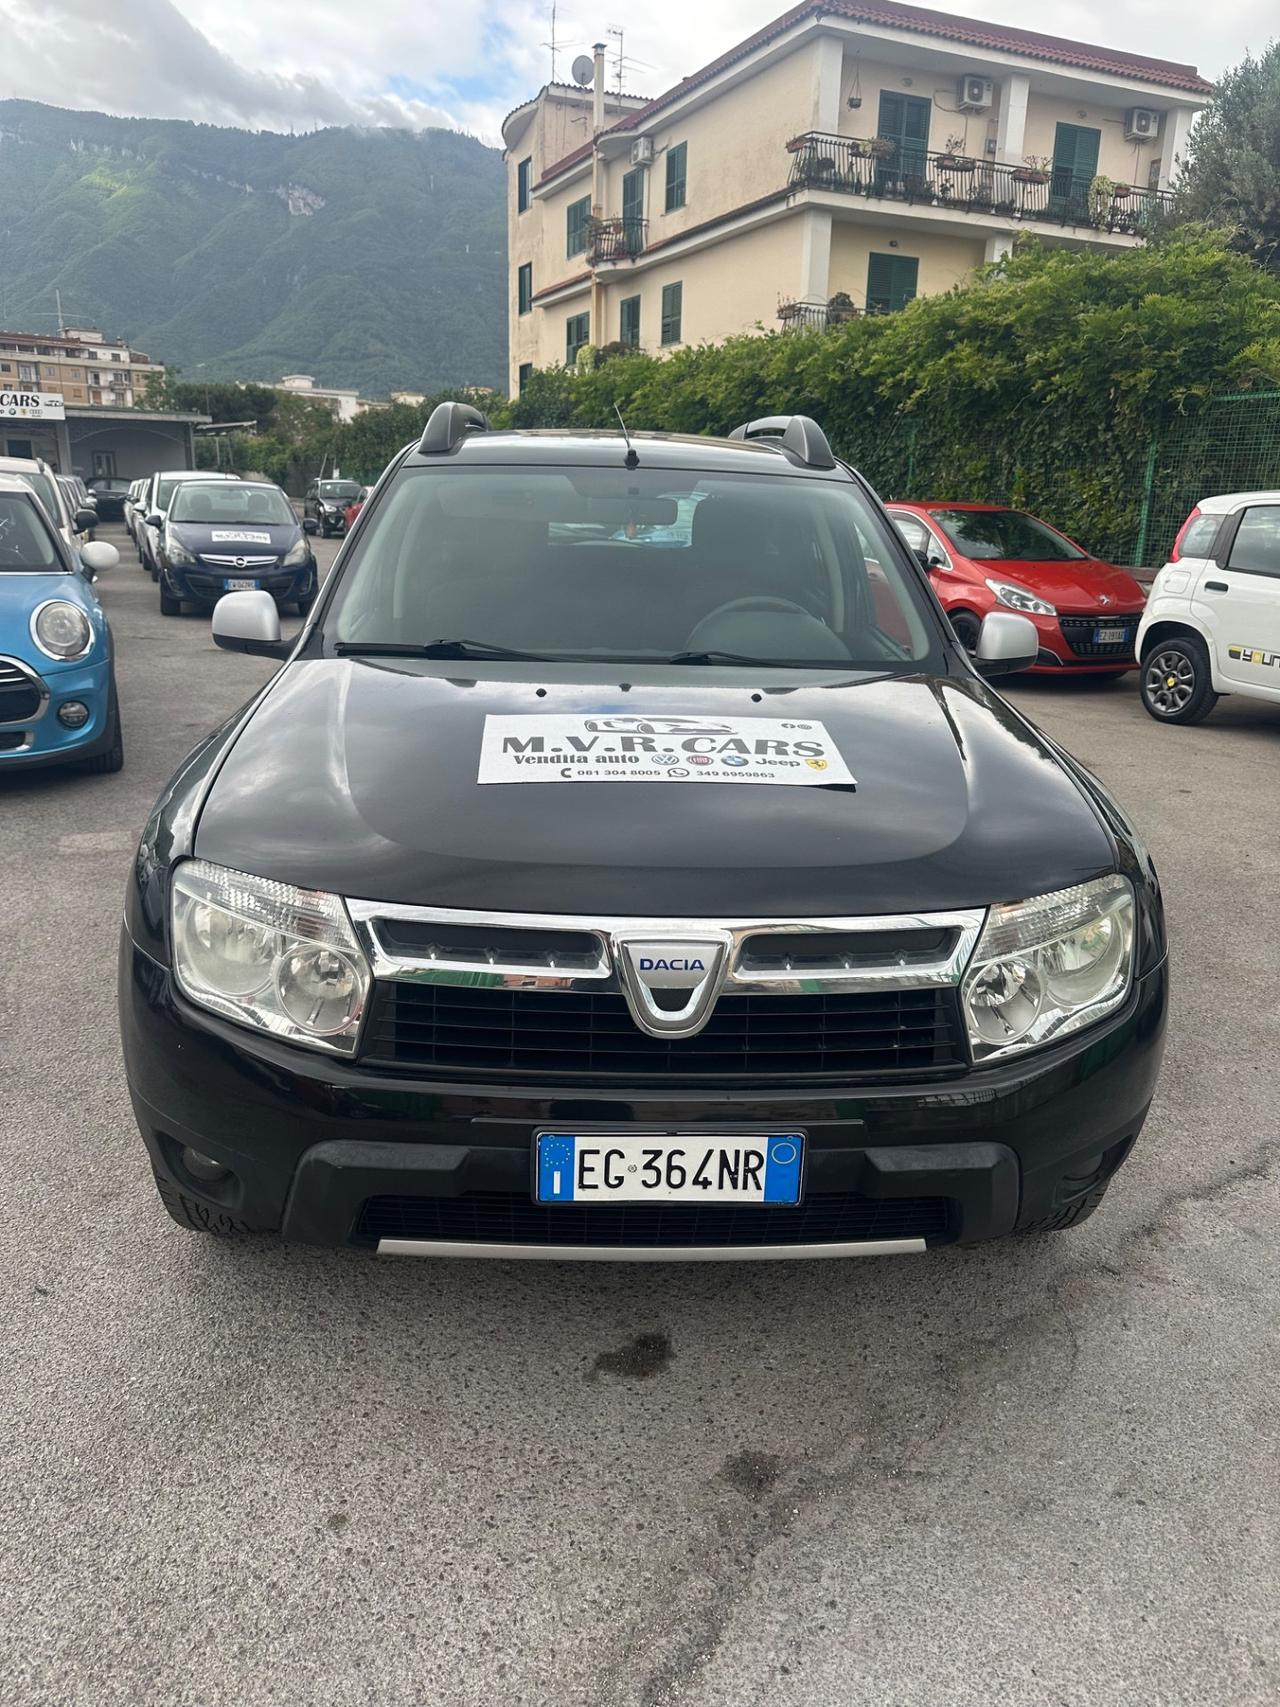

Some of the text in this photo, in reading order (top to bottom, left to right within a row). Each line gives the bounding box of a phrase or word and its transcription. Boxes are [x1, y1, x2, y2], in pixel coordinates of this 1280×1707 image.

[0, 393, 40, 408] CARS
[513, 754, 589, 765] Vendita
[595, 753, 640, 764] auto
[755, 757, 801, 768] Jeep
[640, 958, 705, 971] DACIA
[577, 1148, 626, 1190] EG
[641, 1148, 766, 1191] 364NR
